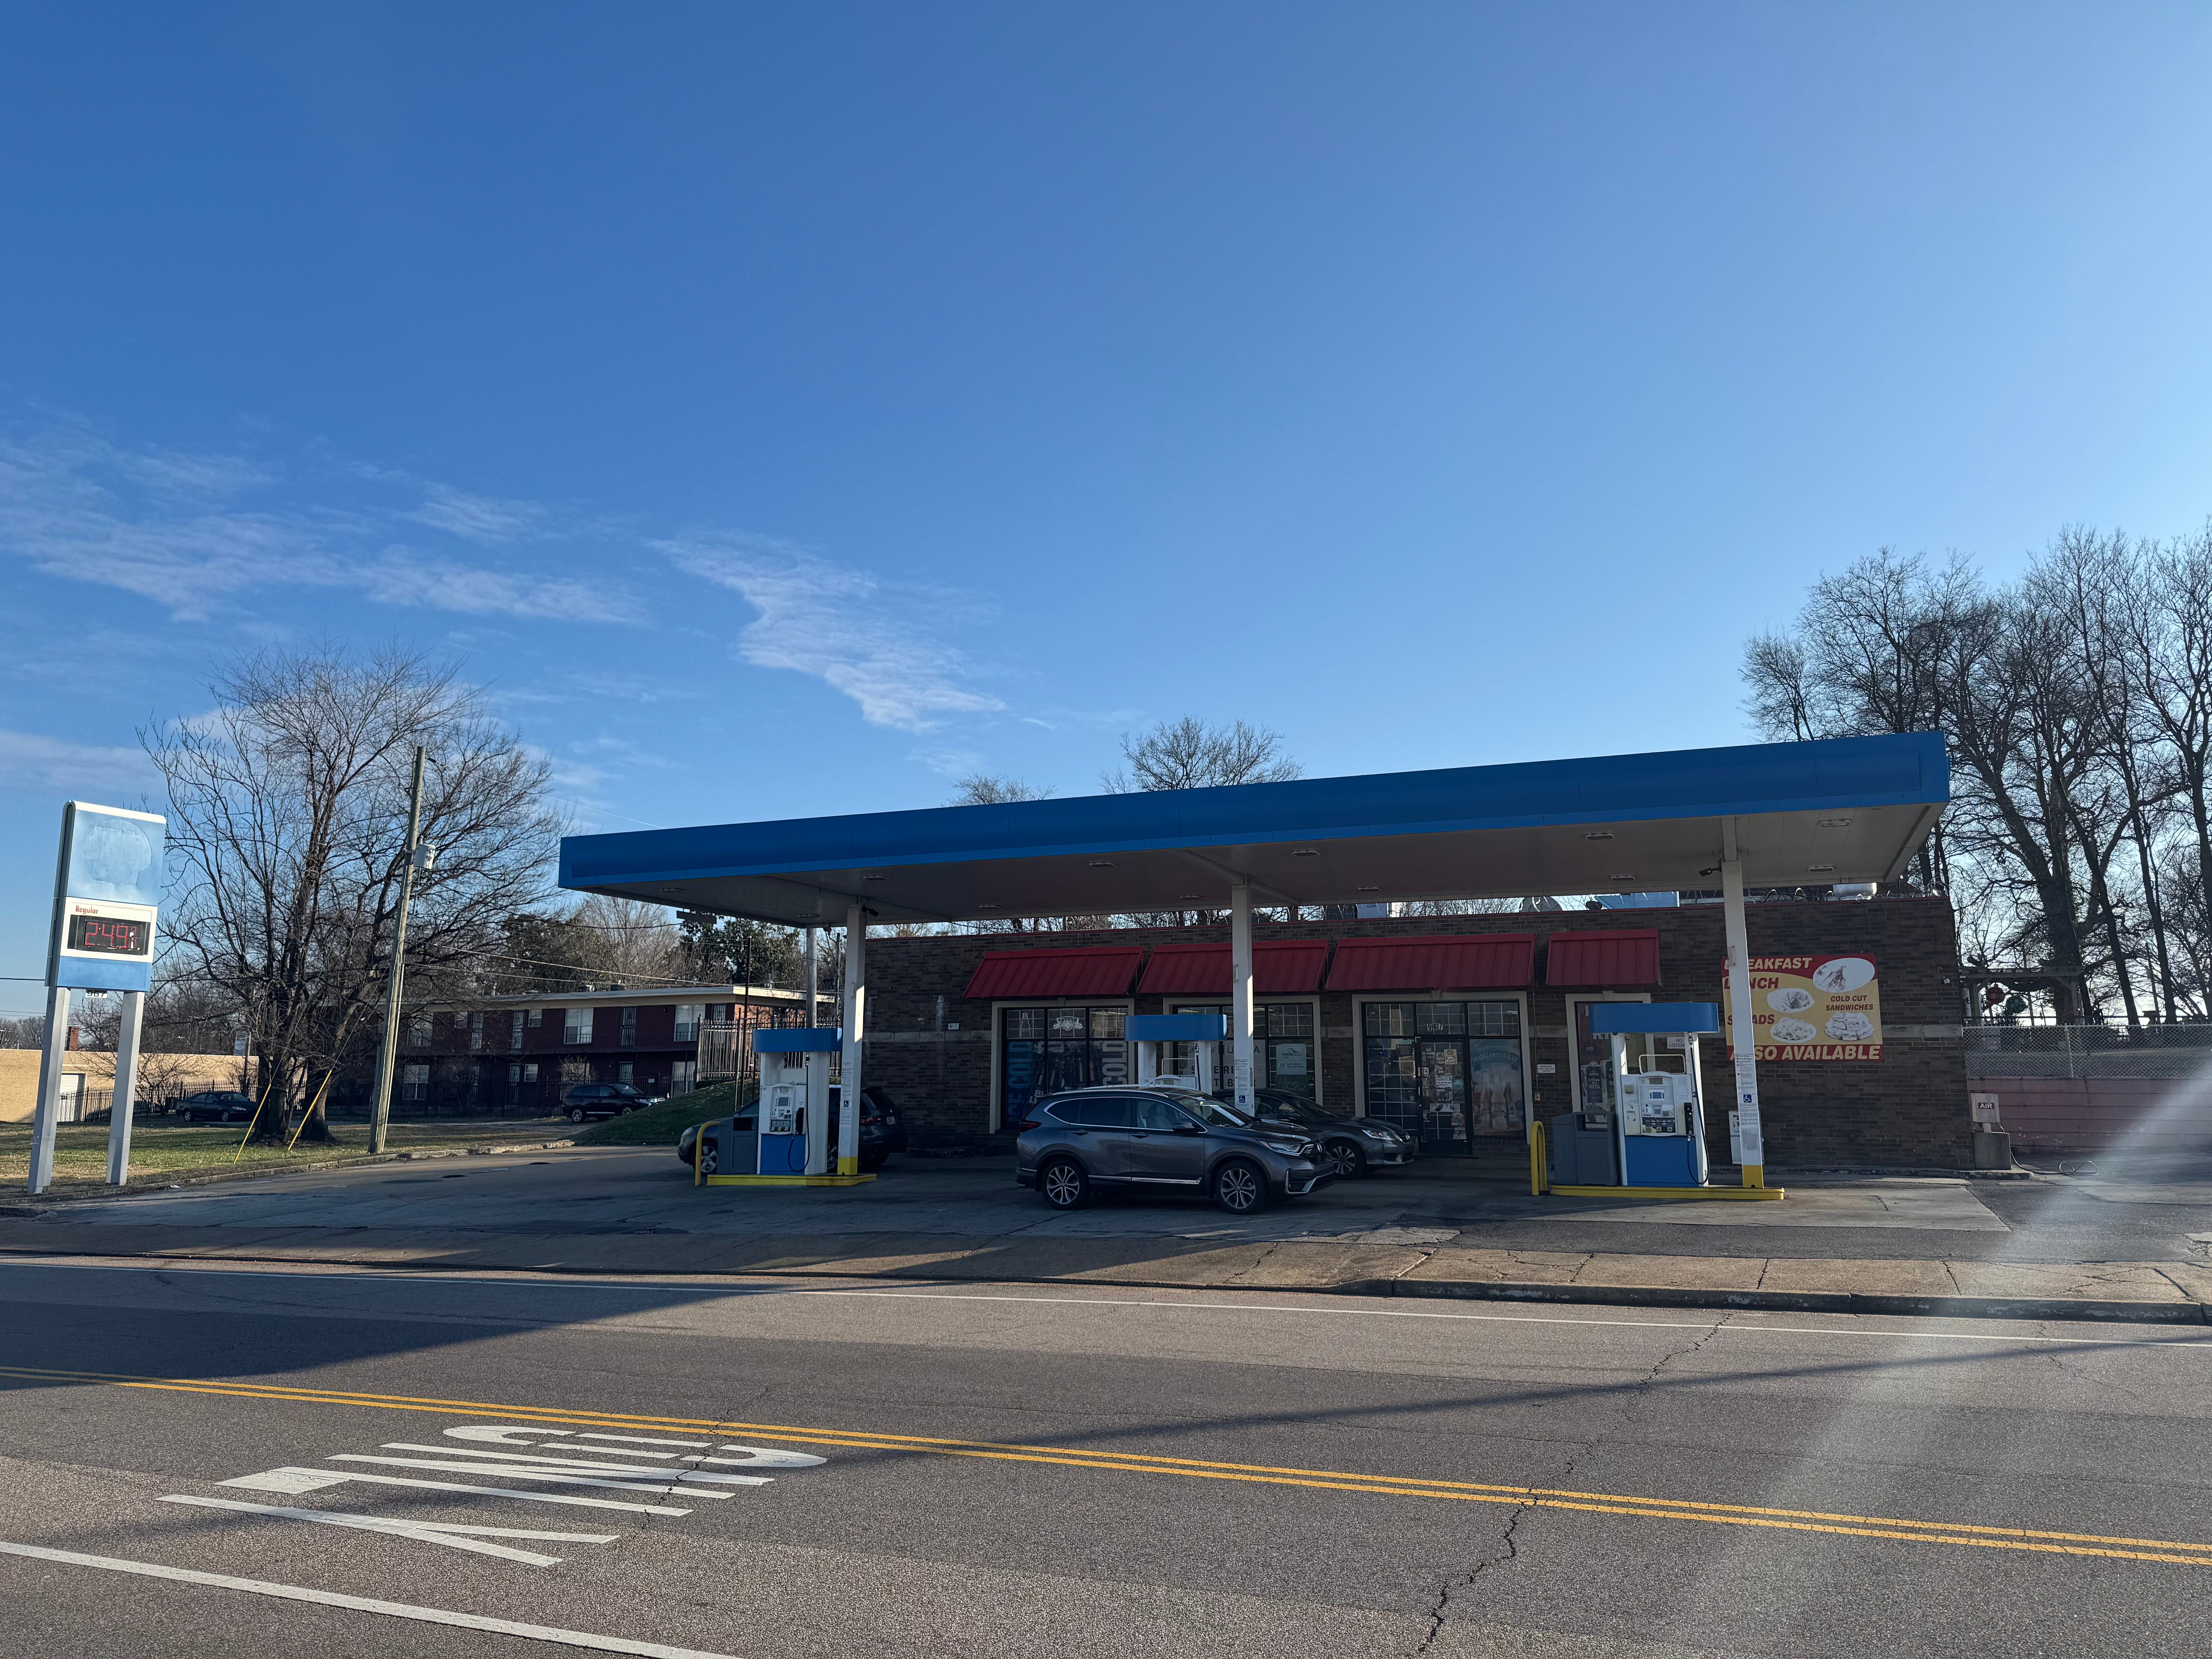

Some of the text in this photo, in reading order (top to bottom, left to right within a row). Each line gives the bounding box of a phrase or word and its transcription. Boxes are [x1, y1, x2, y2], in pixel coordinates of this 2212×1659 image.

[76, 905, 98, 914] Regular
[1724, 957, 1813, 970] EAKFAST
[1724, 977, 1779, 989] LNCH
[1728, 1014, 1775, 1025] SADS
[1472, 1053, 1518, 1062] MARGARITAVILLE
[1730, 1045, 1881, 1061] SO AVAILABLE
[1008, 1041, 1033, 1089] COLD
[154, 1425, 829, 1568] ONLY
